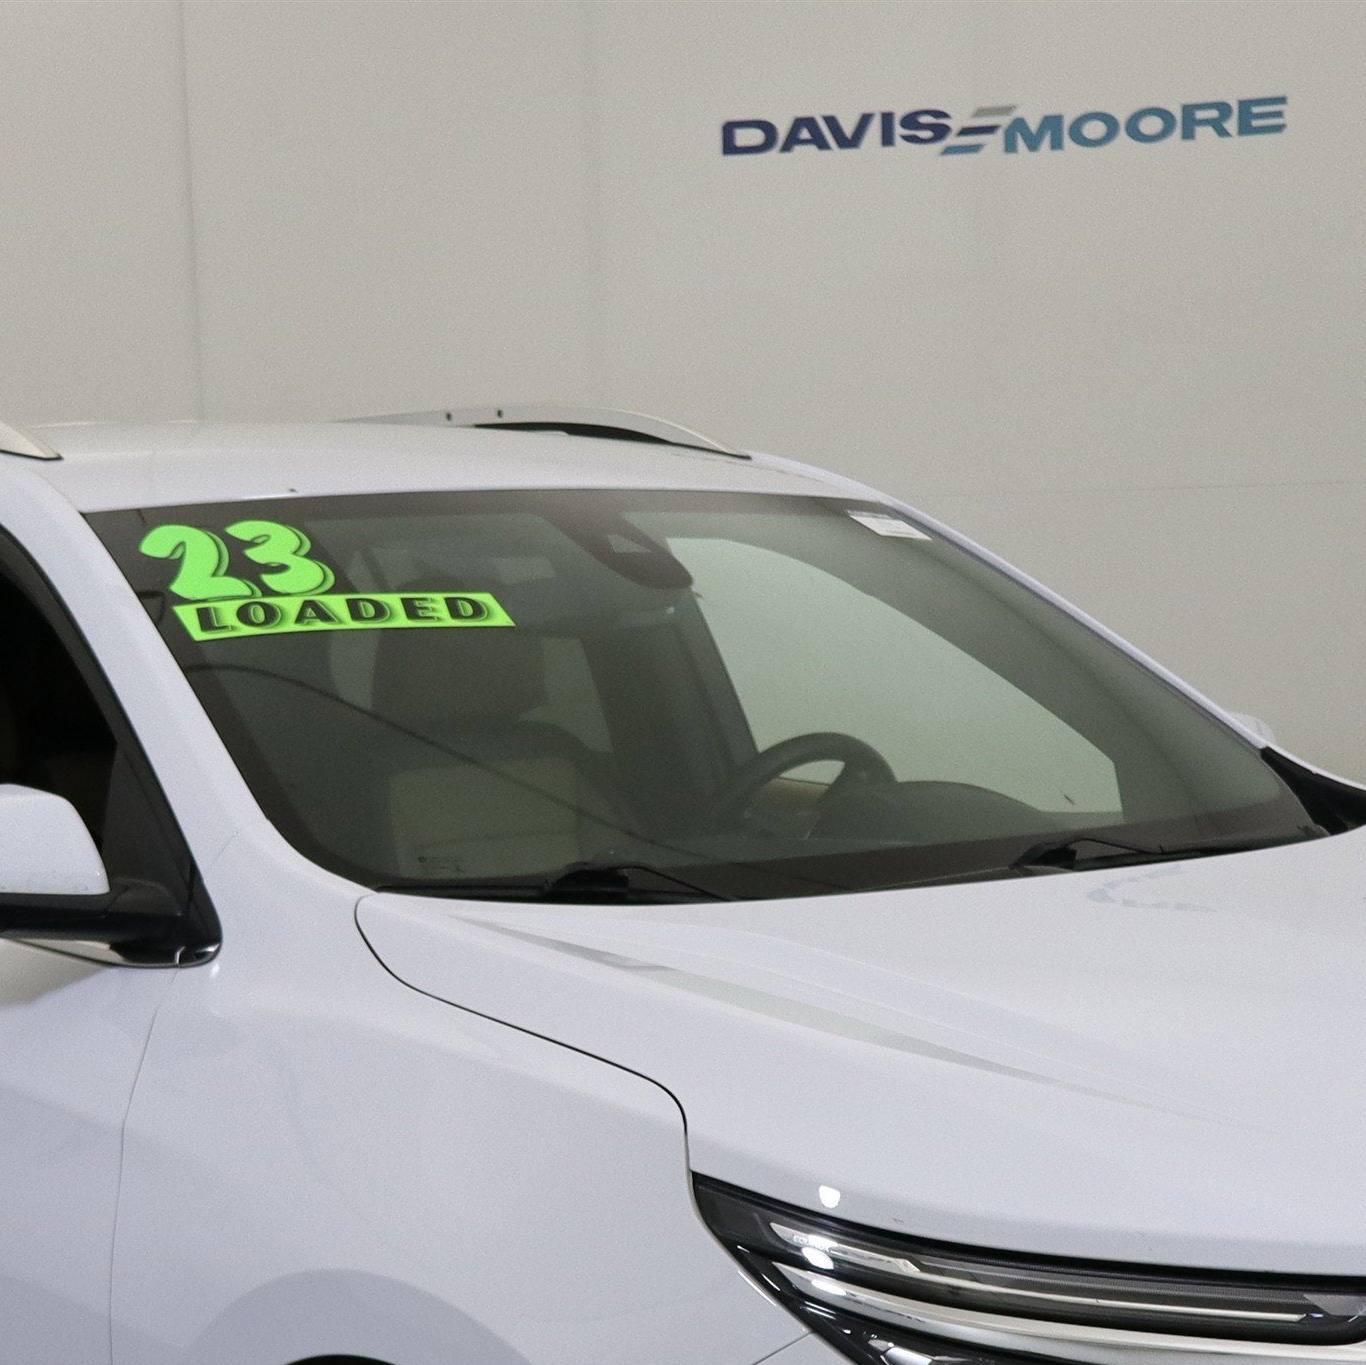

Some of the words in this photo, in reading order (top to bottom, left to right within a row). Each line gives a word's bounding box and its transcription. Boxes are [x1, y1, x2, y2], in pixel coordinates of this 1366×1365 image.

[721, 109, 952, 155] DAVIS
[1004, 95, 1288, 154] MOORE
[138, 519, 335, 601] 23
[195, 595, 490, 634] LOADED
